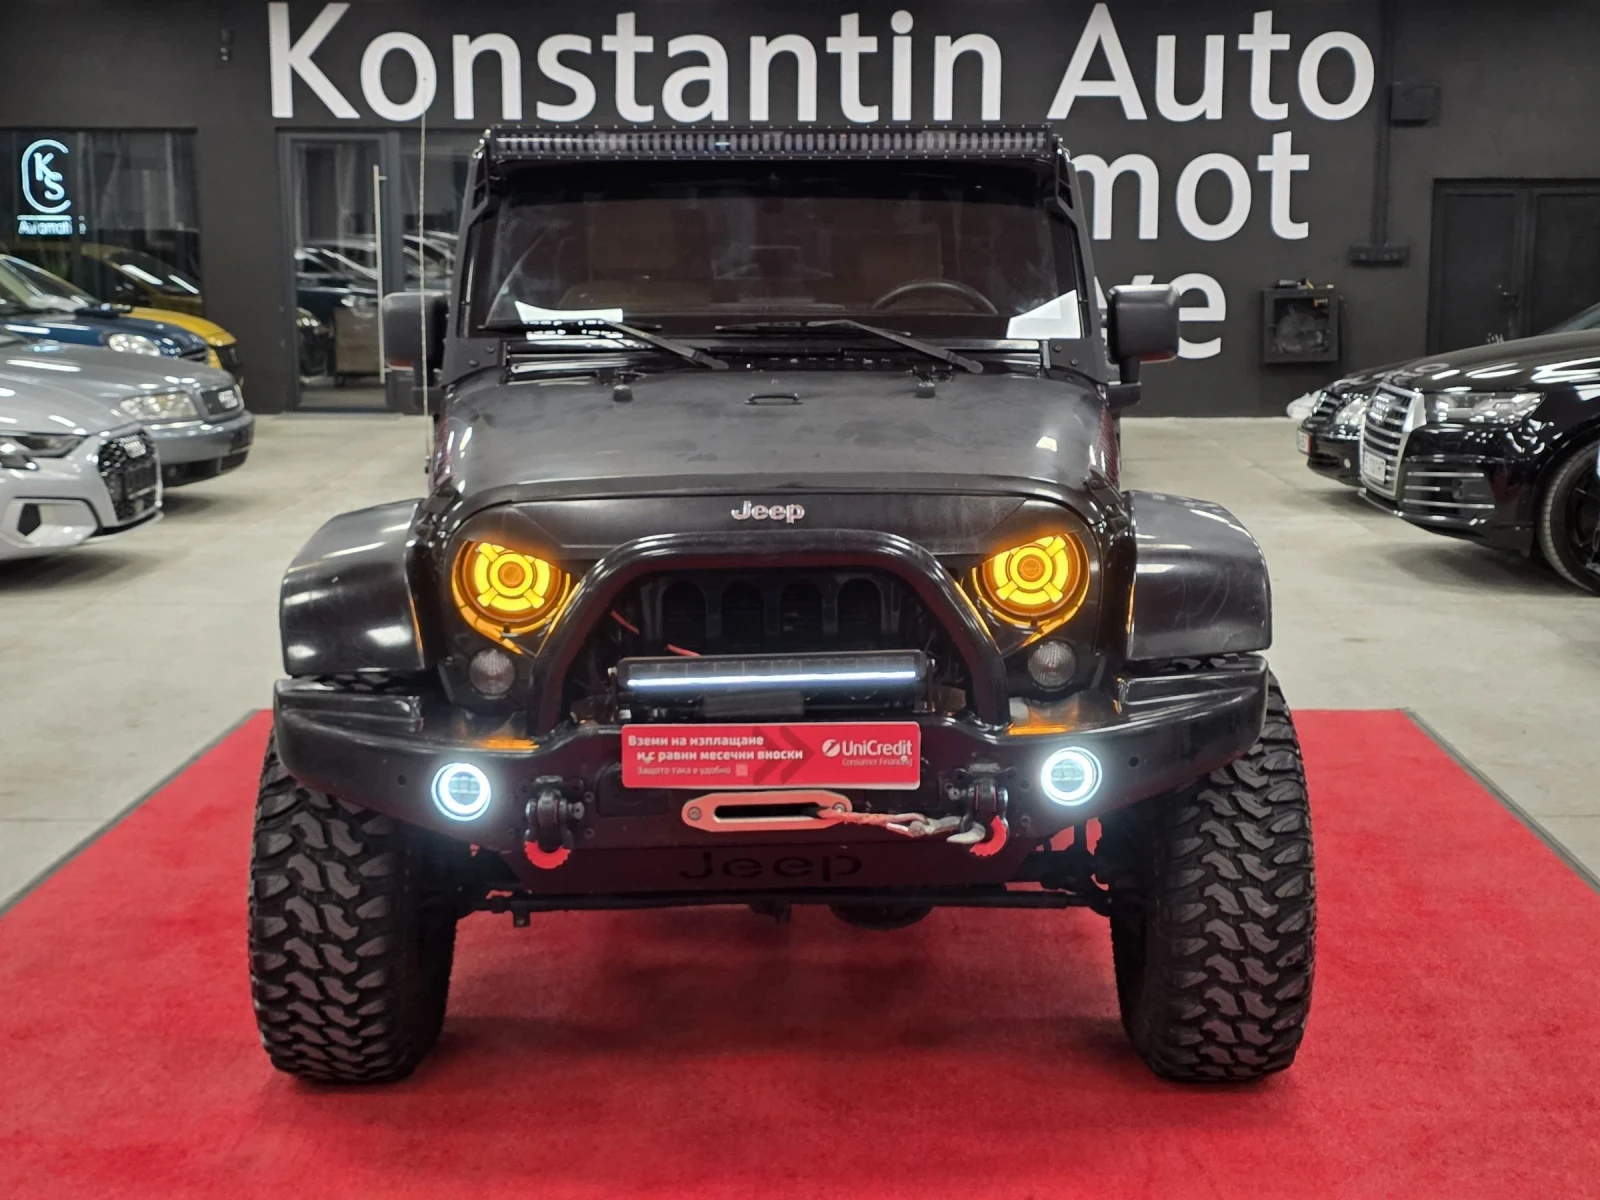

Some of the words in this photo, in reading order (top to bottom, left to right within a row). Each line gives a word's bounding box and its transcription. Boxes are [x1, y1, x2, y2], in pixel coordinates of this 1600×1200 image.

[269, 3, 1002, 123] Konstantin
[1046, 3, 1375, 122] Auto
[731, 500, 805, 524] Jeep
[628, 735, 668, 746] Вземи
[671, 737, 687, 746] на
[690, 736, 764, 748] изплащане
[841, 739, 913, 756] UniCredit
[658, 751, 697, 762] равни
[700, 751, 755, 760] месечни
[758, 750, 803, 760] вноски
[842, 758, 878, 767] Consumer
[680, 852, 862, 882] Jeep
